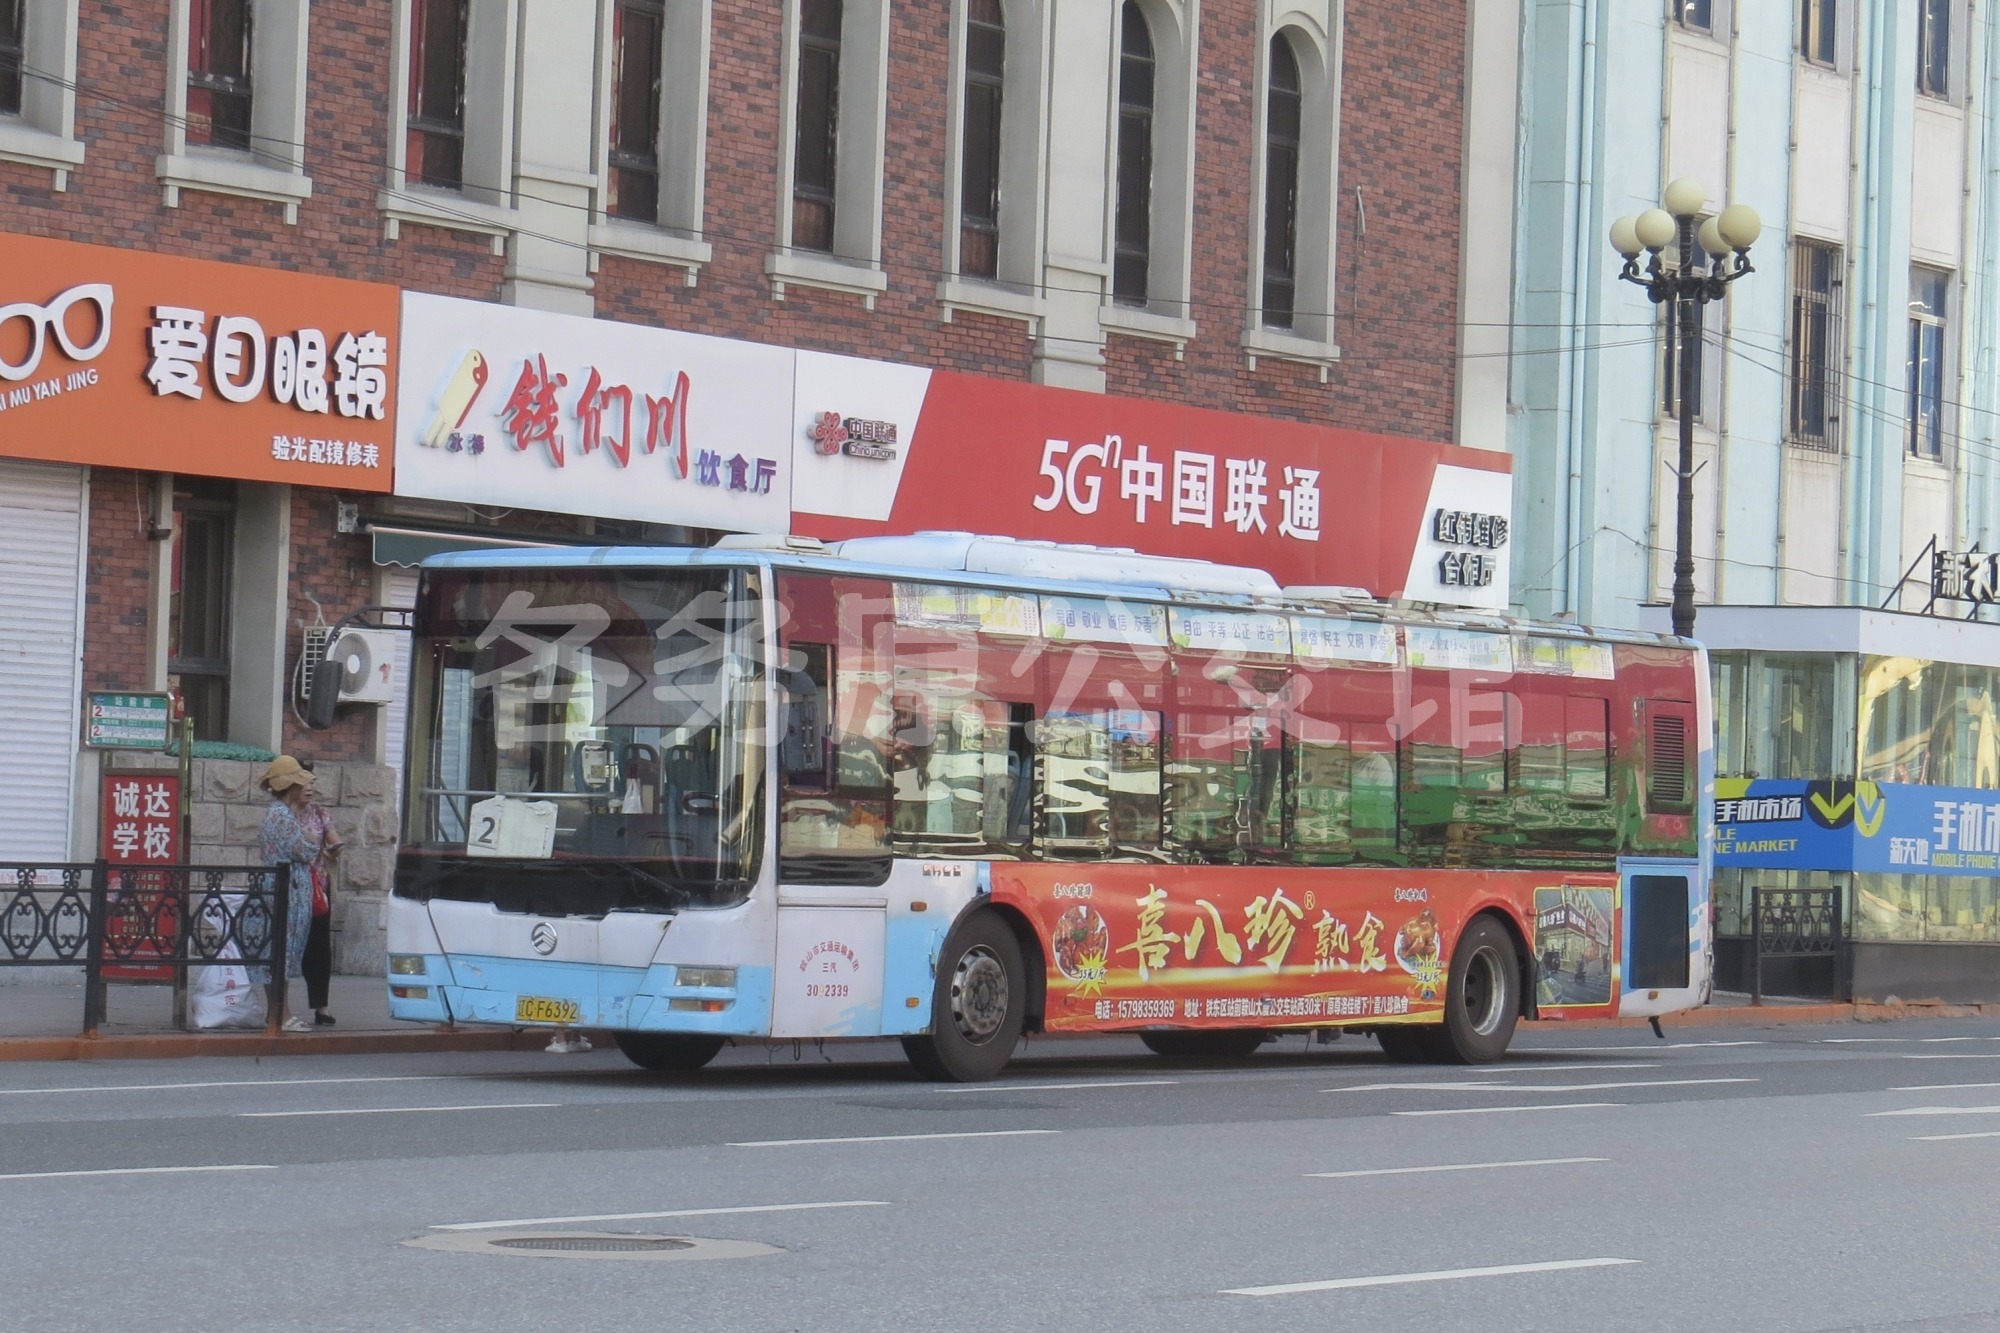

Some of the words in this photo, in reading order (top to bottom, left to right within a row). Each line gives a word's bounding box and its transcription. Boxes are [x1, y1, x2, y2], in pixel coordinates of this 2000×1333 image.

[147, 306, 387, 420] 爱目眼镜
[9, 387, 31, 408] MU
[32, 378, 61, 400] YAN
[65, 368, 99, 391] JING
[849, 418, 897, 444] 中国联通
[272, 435, 379, 468] 验光配镜修表
[697, 449, 776, 494] 饮食厅
[1441, 552, 1496, 586] 合作厅
[1936, 550, 2000, 602] 新天
[1082, 611, 1101, 629] 敬业
[1184, 619, 1201, 636] 自由
[1208, 621, 1226, 638] 平等
[1232, 623, 1250, 640] 公正
[95, 706, 102, 717] 2
[93, 726, 101, 737] 2
[112, 782, 170, 818] 诚达
[1716, 797, 1802, 822] 手机市场
[112, 823, 170, 859] 学校
[478, 817, 495, 844] 2
[1736, 839, 1798, 853] MARKET
[1889, 837, 1928, 865] 新天地
[1932, 853, 1964, 868] MOBILE
[1966, 854, 1997, 869] PHONE
